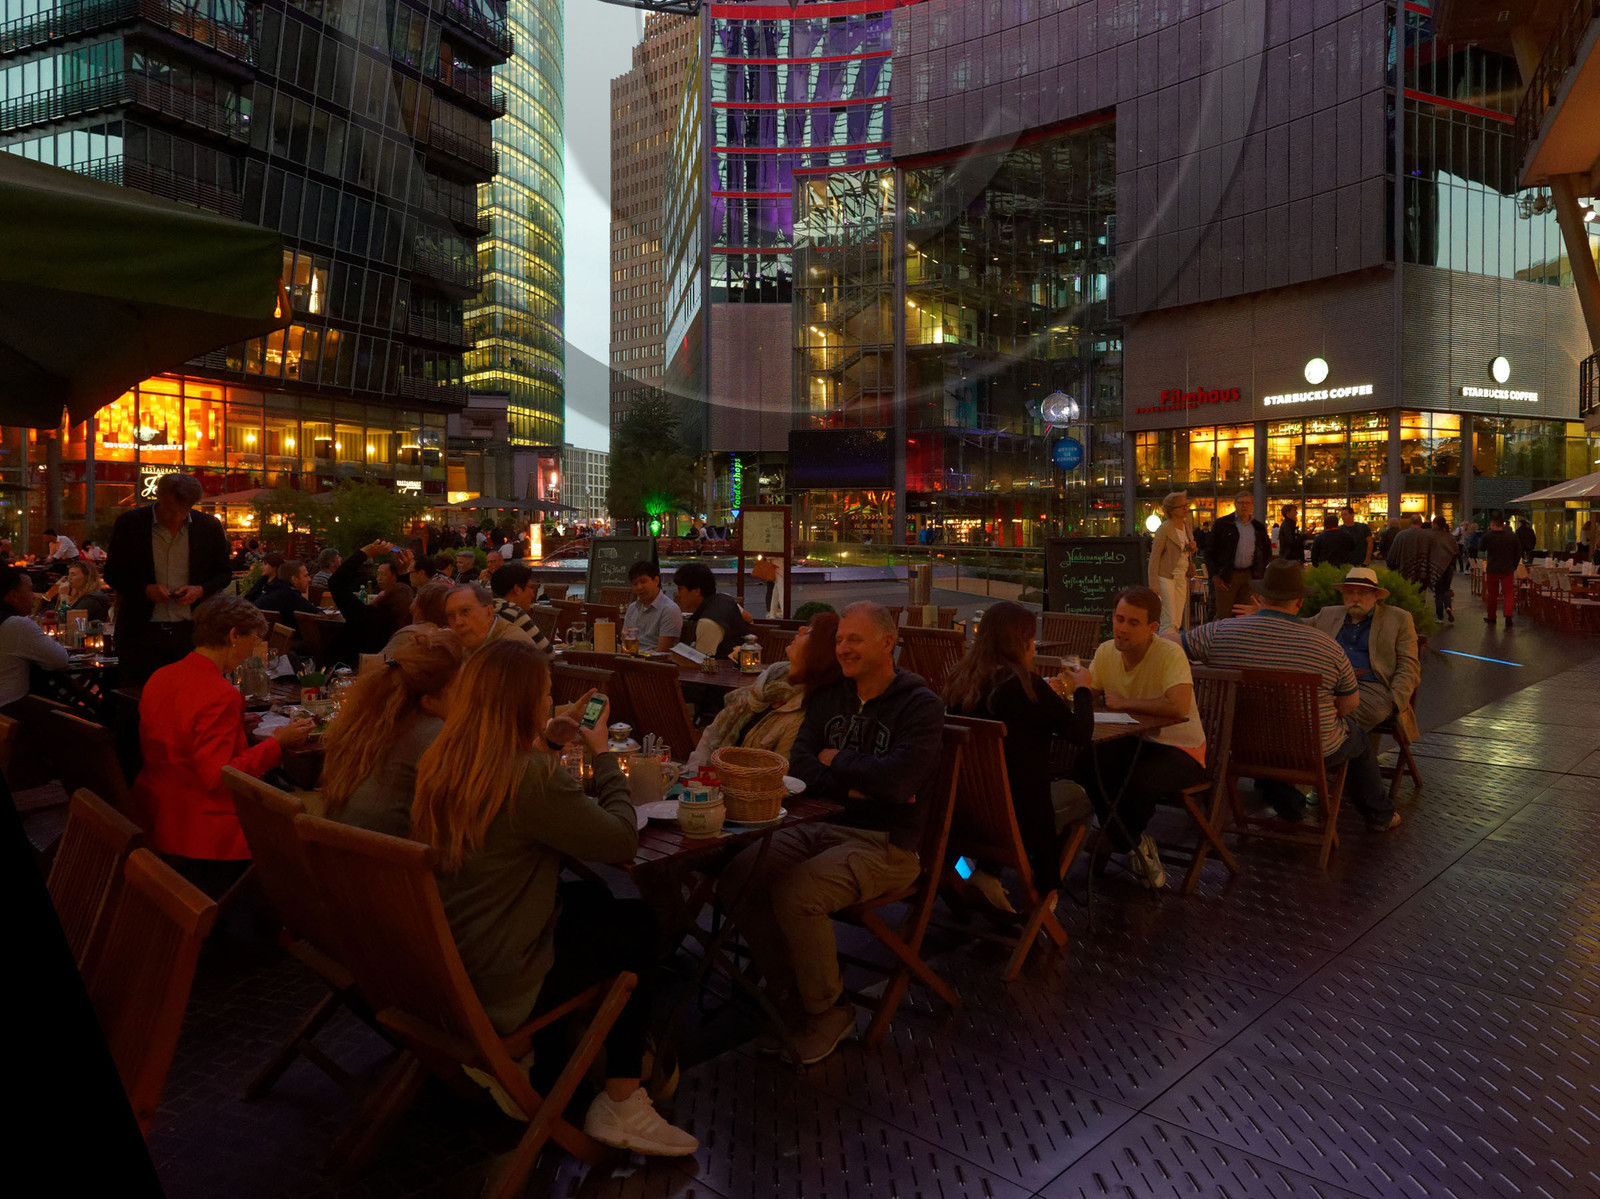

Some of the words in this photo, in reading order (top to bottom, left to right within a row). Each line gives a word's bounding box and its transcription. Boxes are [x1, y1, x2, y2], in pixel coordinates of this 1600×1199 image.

[1160, 387, 1240, 405] Filmhaus
[1263, 387, 1328, 407] STARBUCKS
[1329, 384, 1374, 400] COFFEE
[1462, 386, 1510, 400] STARBUCKS
[1510, 388, 1539, 402] COFFEE
[824, 714, 891, 753] GAP
